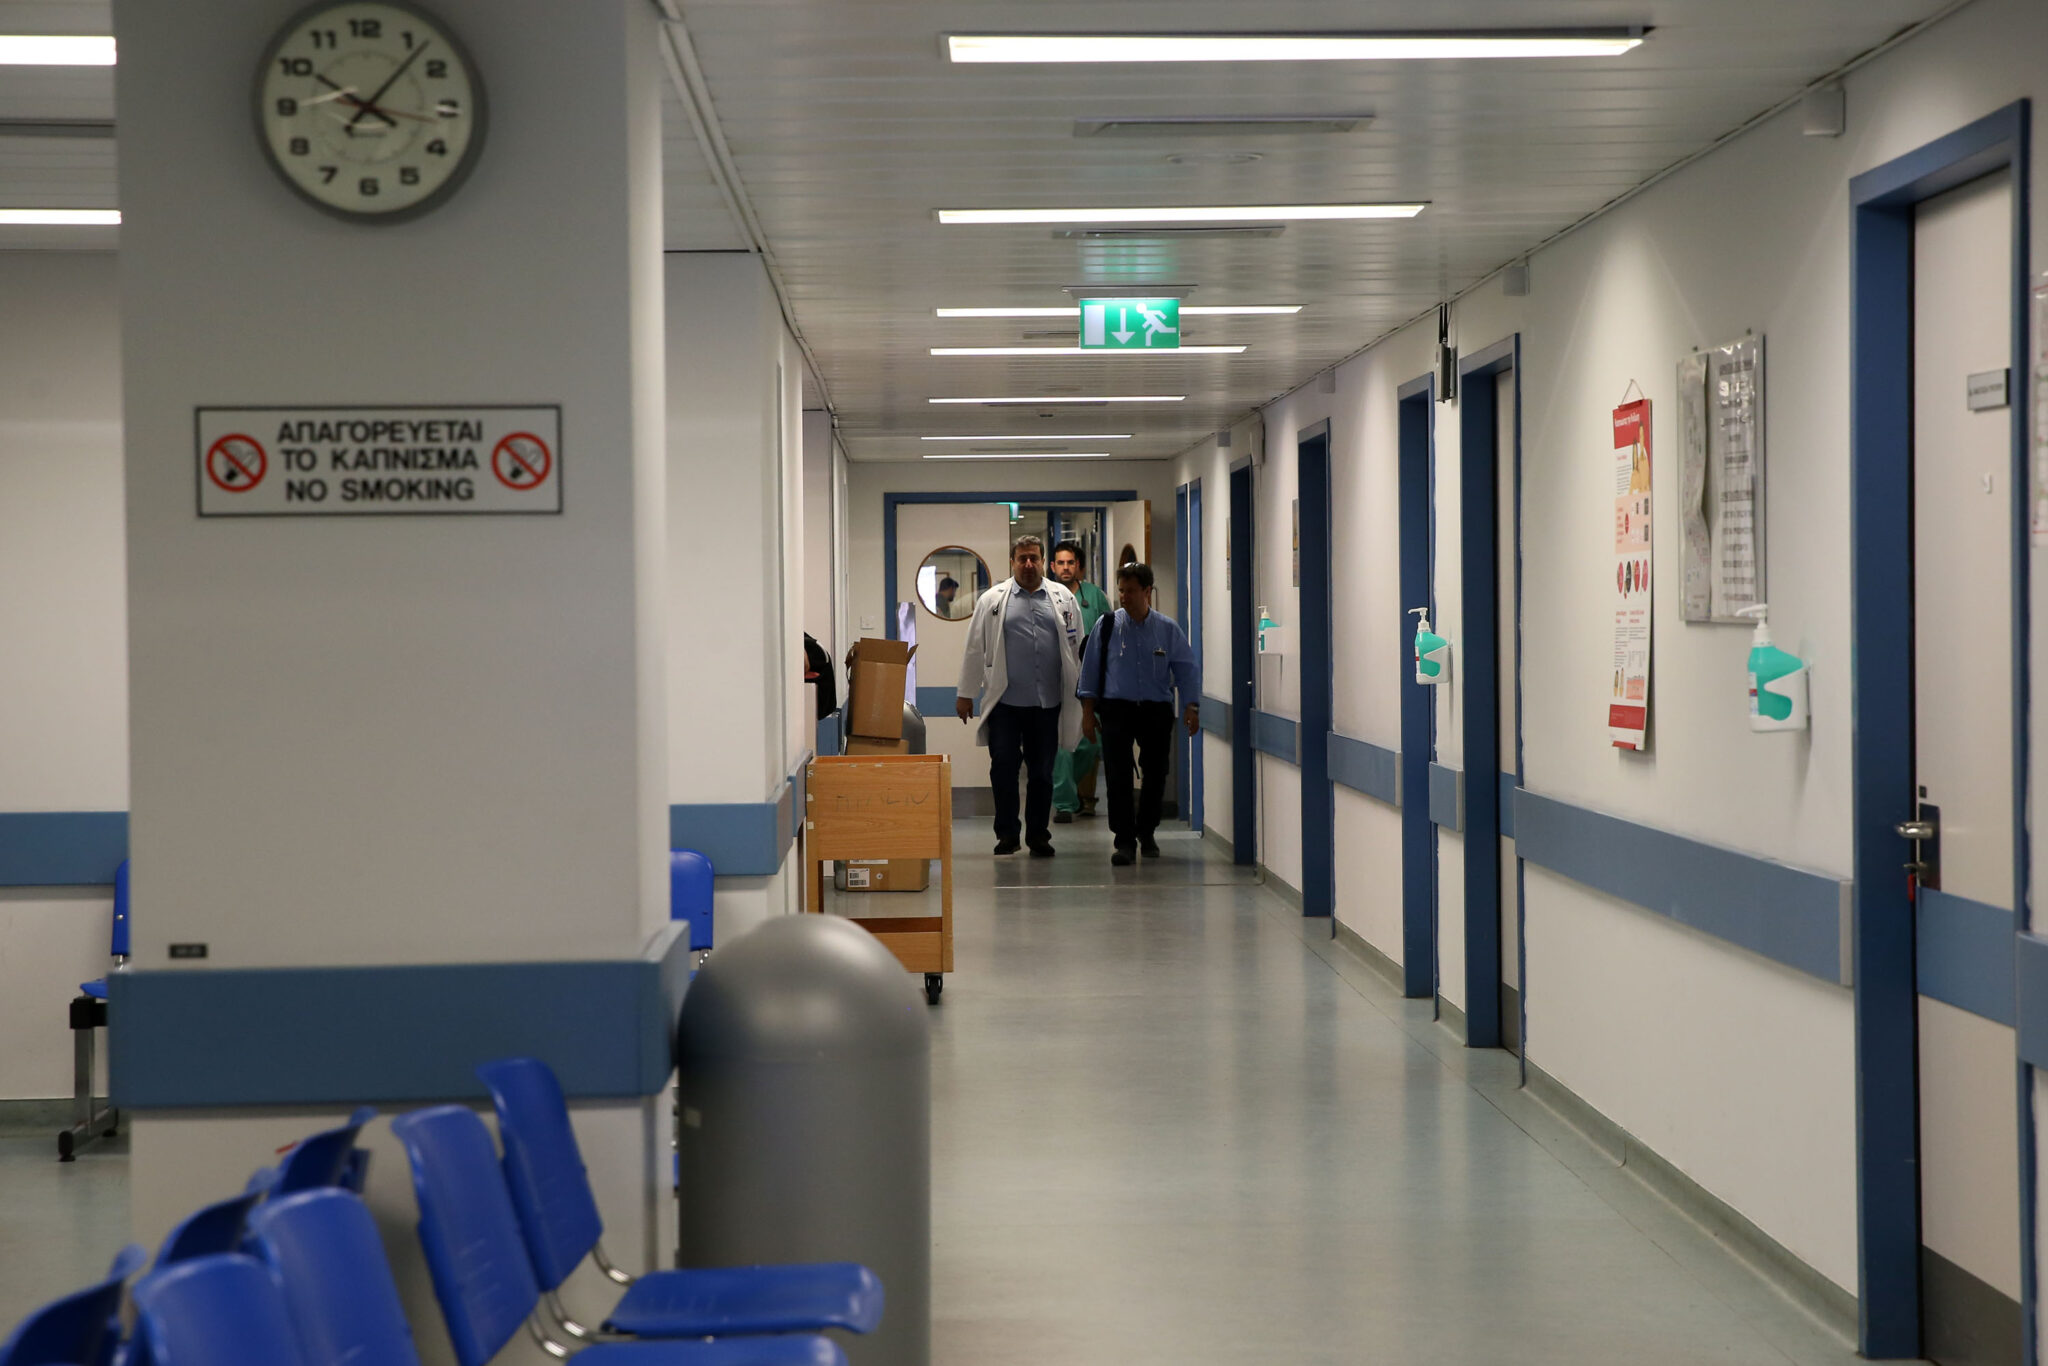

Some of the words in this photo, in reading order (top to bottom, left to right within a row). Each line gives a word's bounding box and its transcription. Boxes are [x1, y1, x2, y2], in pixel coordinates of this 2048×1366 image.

[348, 19, 381, 38] 12
[310, 30, 336, 49] 11
[402, 31, 413, 50] 1
[279, 56, 313, 76] 10
[426, 60, 446, 79] 2
[277, 97, 297, 116] 9
[290, 137, 311, 156] 8
[425, 138, 447, 157] 4
[318, 165, 339, 185] 7
[400, 166, 420, 186] 5
[359, 178, 380, 197] 6
[278, 420, 482, 442] ΑΠΑΓΟΡΕΥΕΤΑΙ
[281, 448, 317, 471] ΤΟ
[332, 447, 479, 471] ΚΑΠΝΙΣΜΑ
[286, 479, 327, 502] NO
[342, 477, 473, 502] SMOKING
